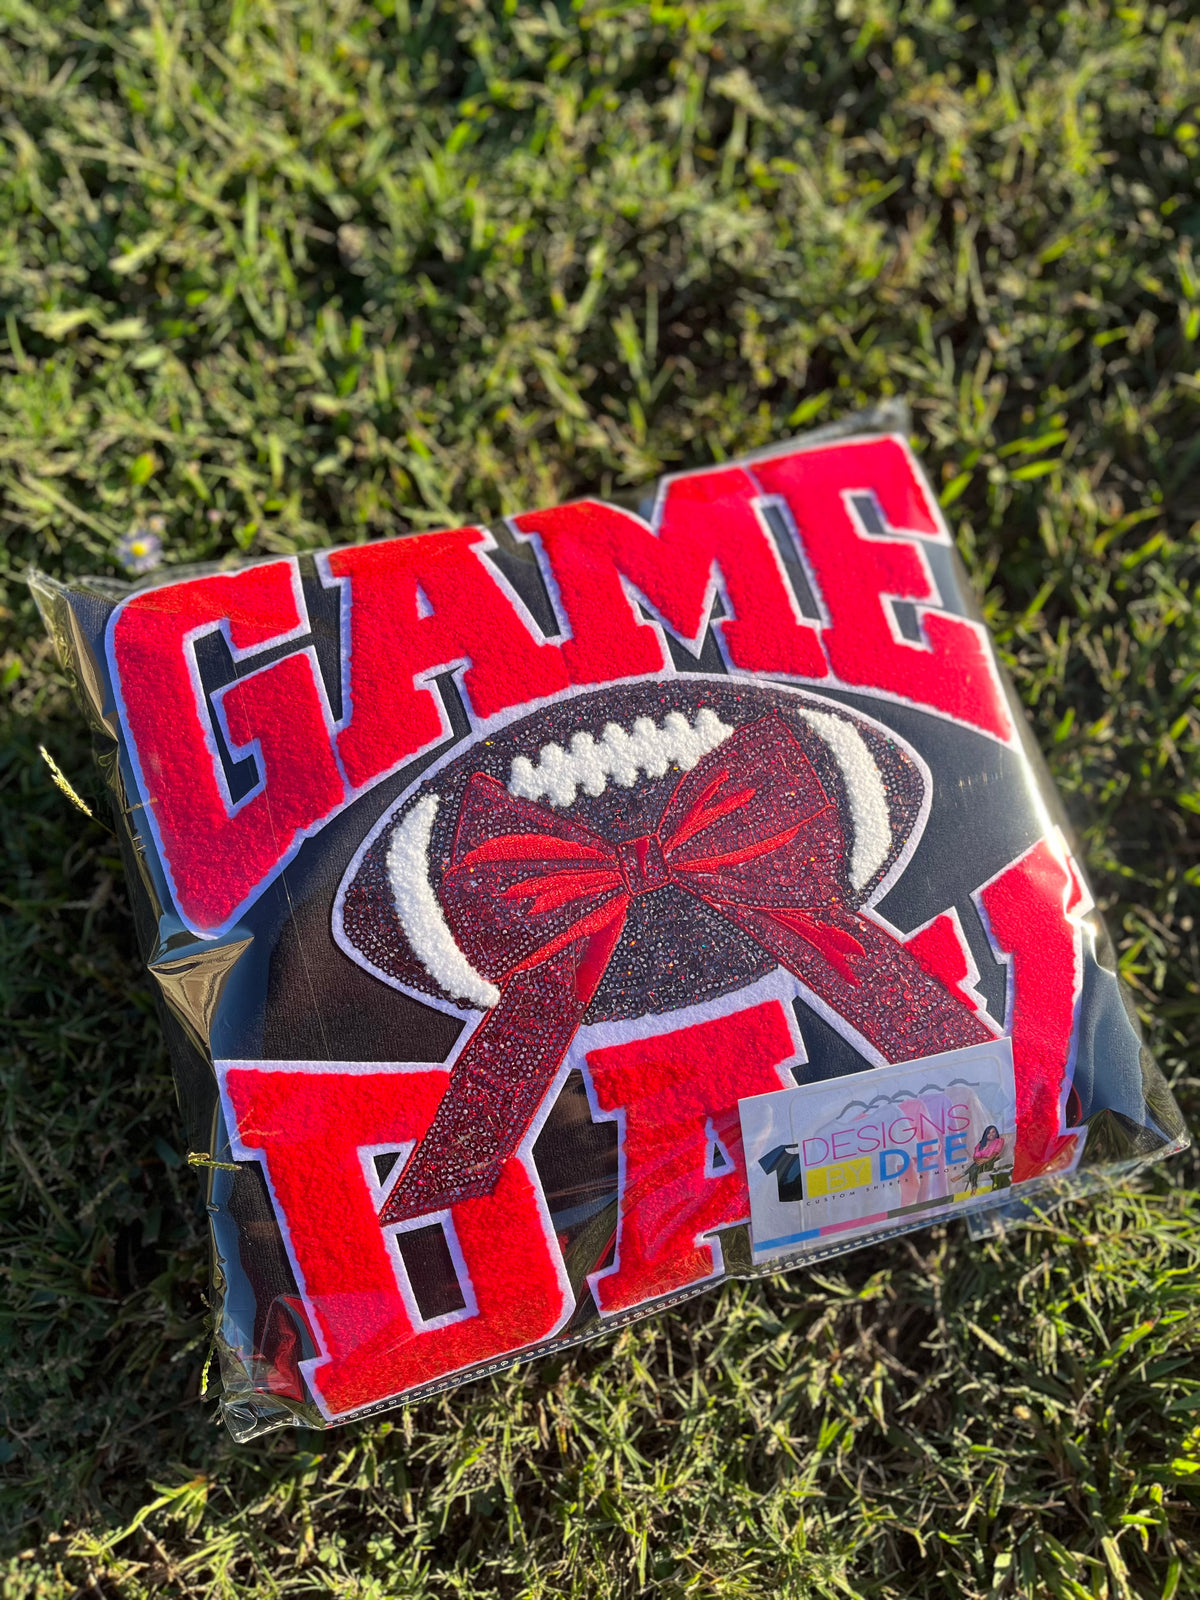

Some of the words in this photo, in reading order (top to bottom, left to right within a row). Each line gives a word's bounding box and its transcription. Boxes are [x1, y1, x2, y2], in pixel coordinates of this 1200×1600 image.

[106, 433, 1015, 940] GAME
[802, 1104, 971, 1167] DESIGNS
[825, 1160, 866, 1191] BY
[879, 1132, 968, 1182] DEE
[806, 1191, 856, 1207] CUSTOM
[866, 1178, 909, 1192] SHIRTS
[934, 1164, 967, 1176] MORE
